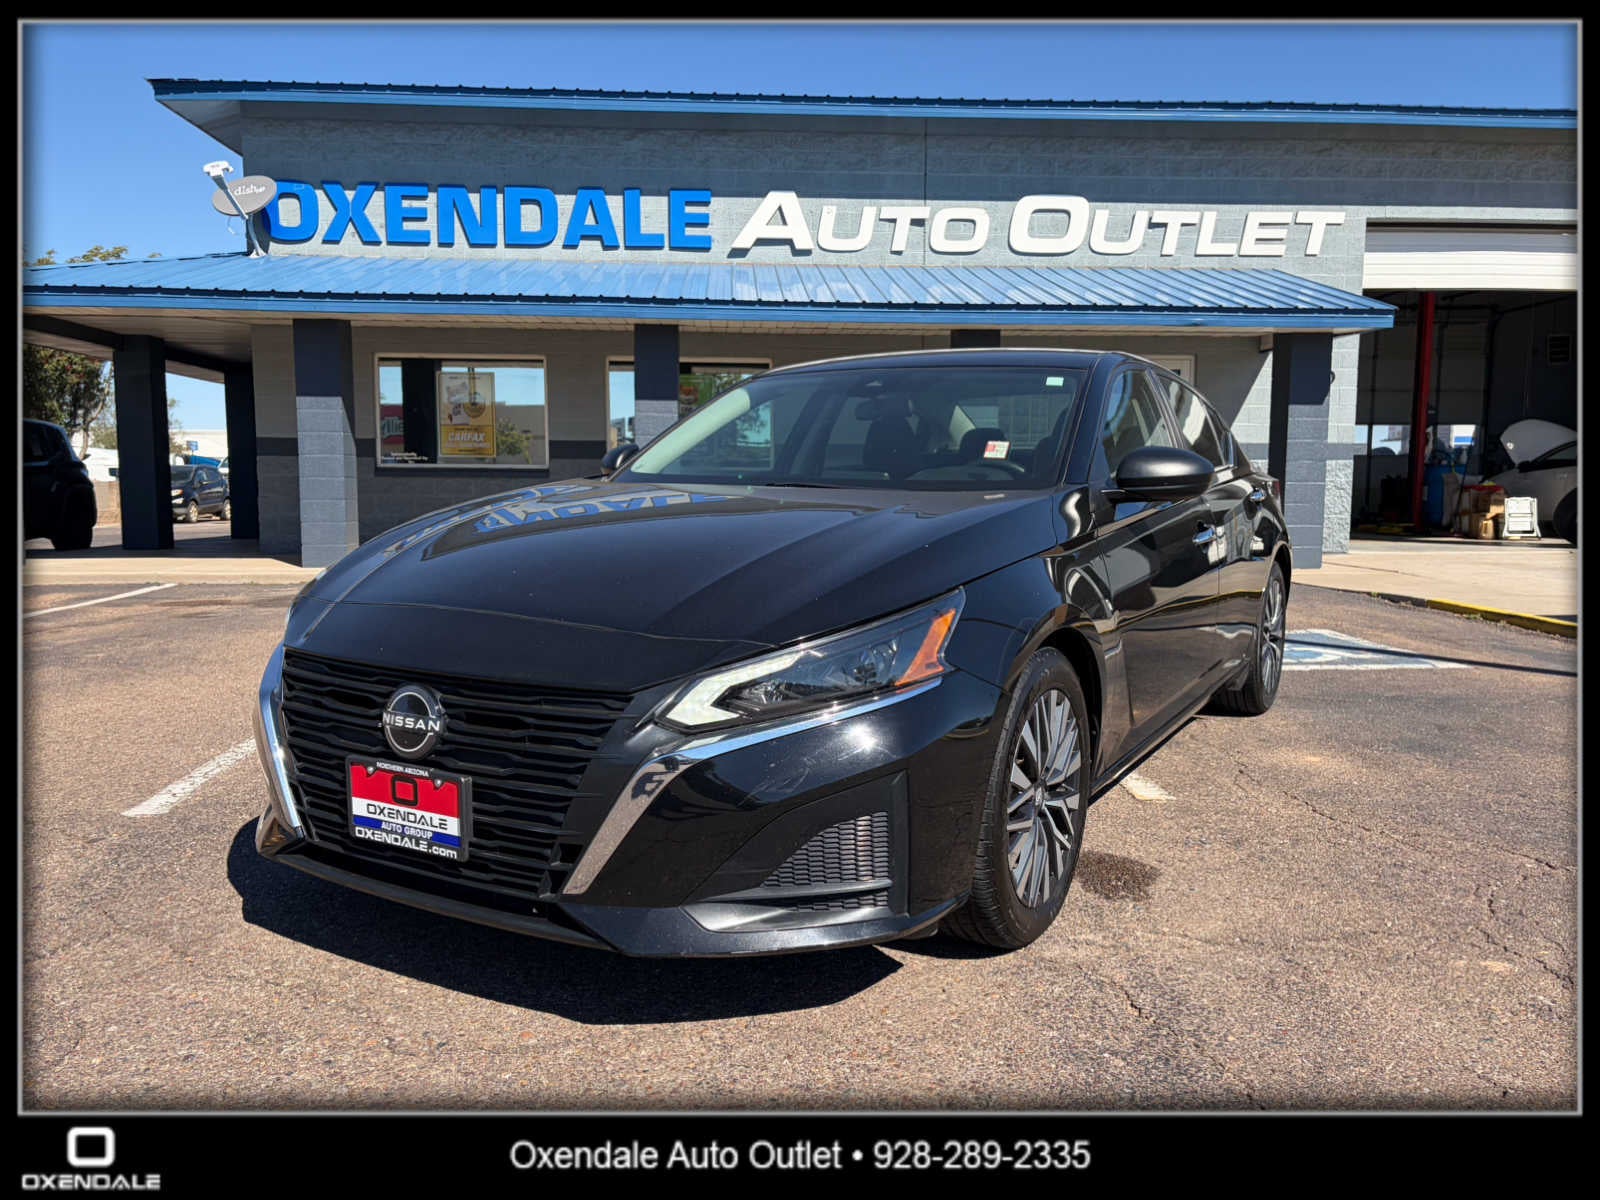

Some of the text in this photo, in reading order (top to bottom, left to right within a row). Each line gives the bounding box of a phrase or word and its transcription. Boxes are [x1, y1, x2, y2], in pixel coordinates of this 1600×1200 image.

[264, 181, 1346, 256] OXENDALE AUTO OUTLET
[448, 432, 486, 442] CARFAX
[383, 712, 440, 731] NISSAN
[367, 803, 448, 830] OXENDALE
[381, 821, 433, 839] AUTO GROUP
[355, 827, 458, 859] OXENDALE.com
